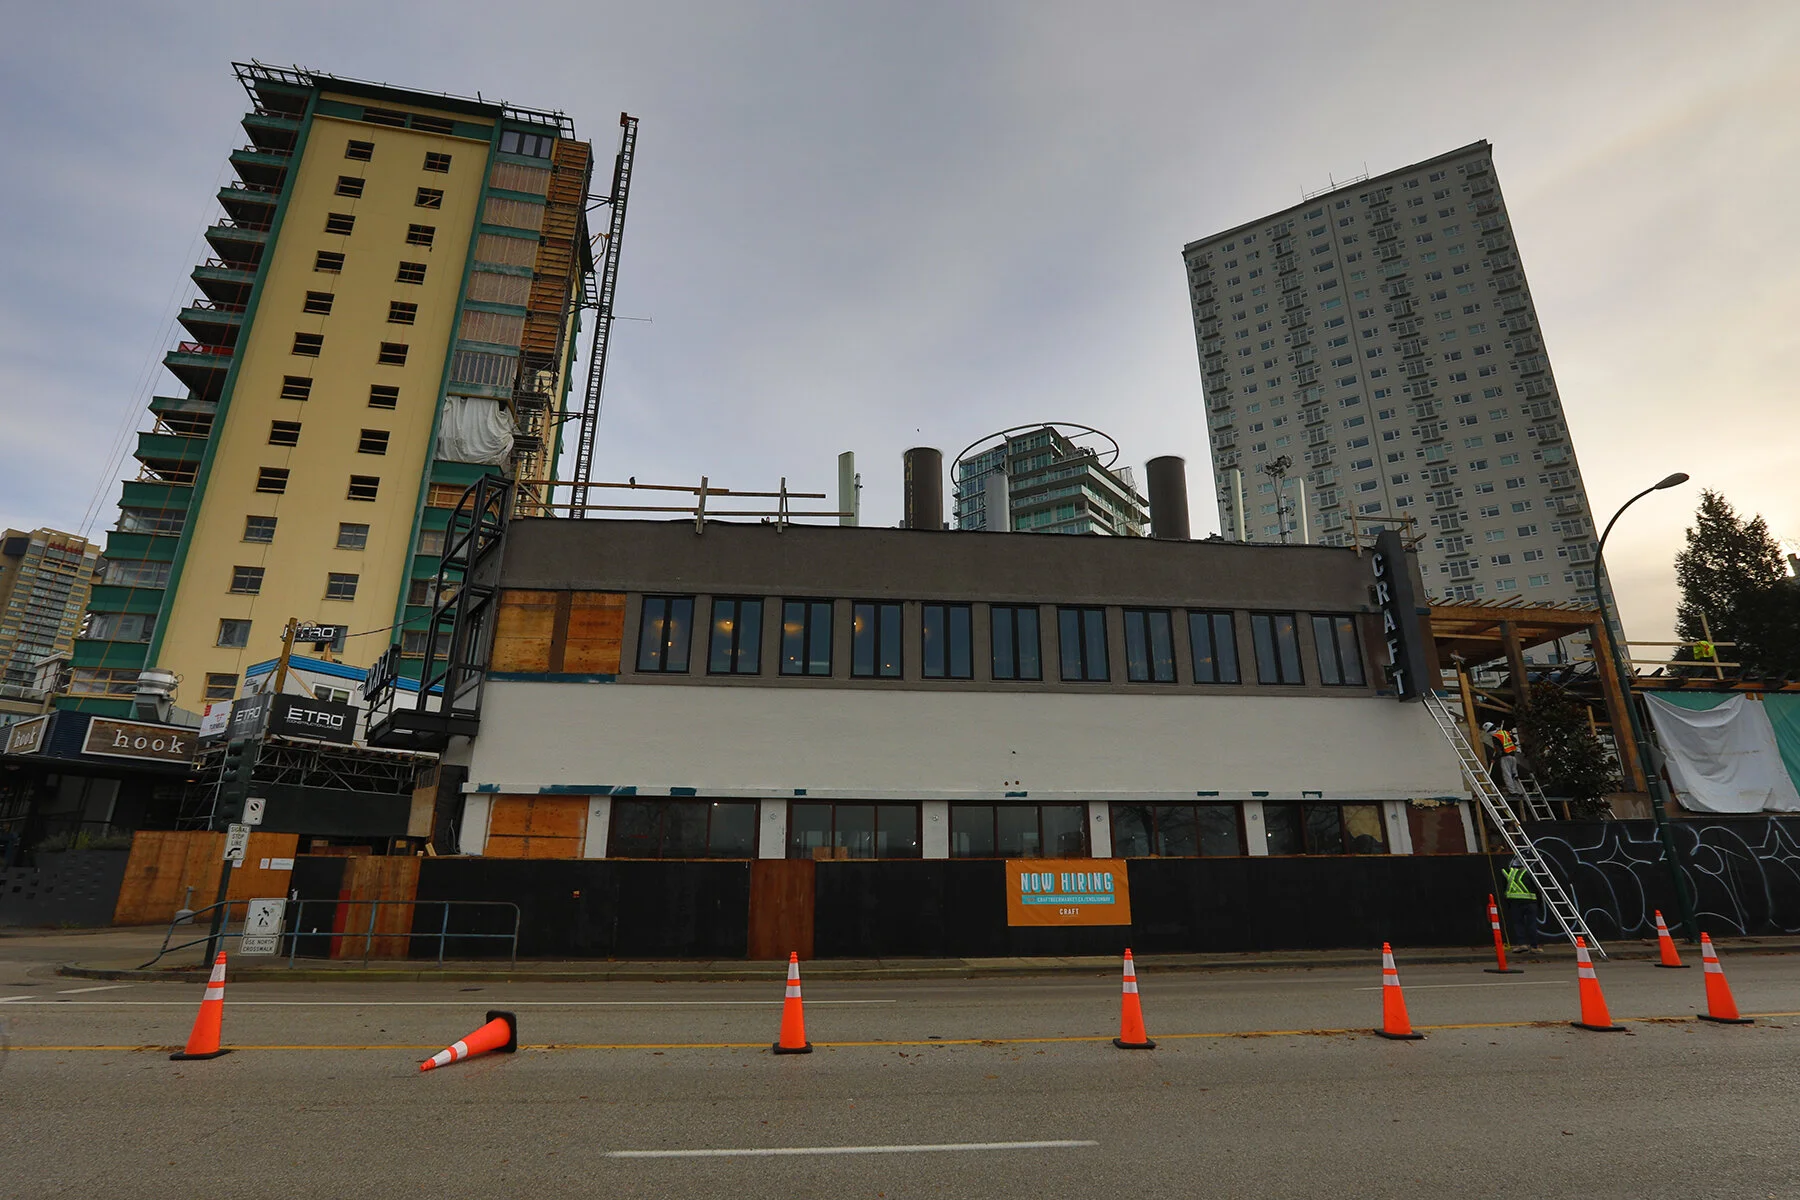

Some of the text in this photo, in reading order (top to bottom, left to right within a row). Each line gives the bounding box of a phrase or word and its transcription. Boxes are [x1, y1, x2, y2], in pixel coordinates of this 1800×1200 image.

[1371, 552, 1404, 695] CRAFT
[235, 706, 261, 722] ETRO
[288, 707, 344, 727] ETRO
[13, 726, 37, 748] hook
[112, 729, 185, 754] hook
[1020, 872, 1114, 893] NOW HIRING
